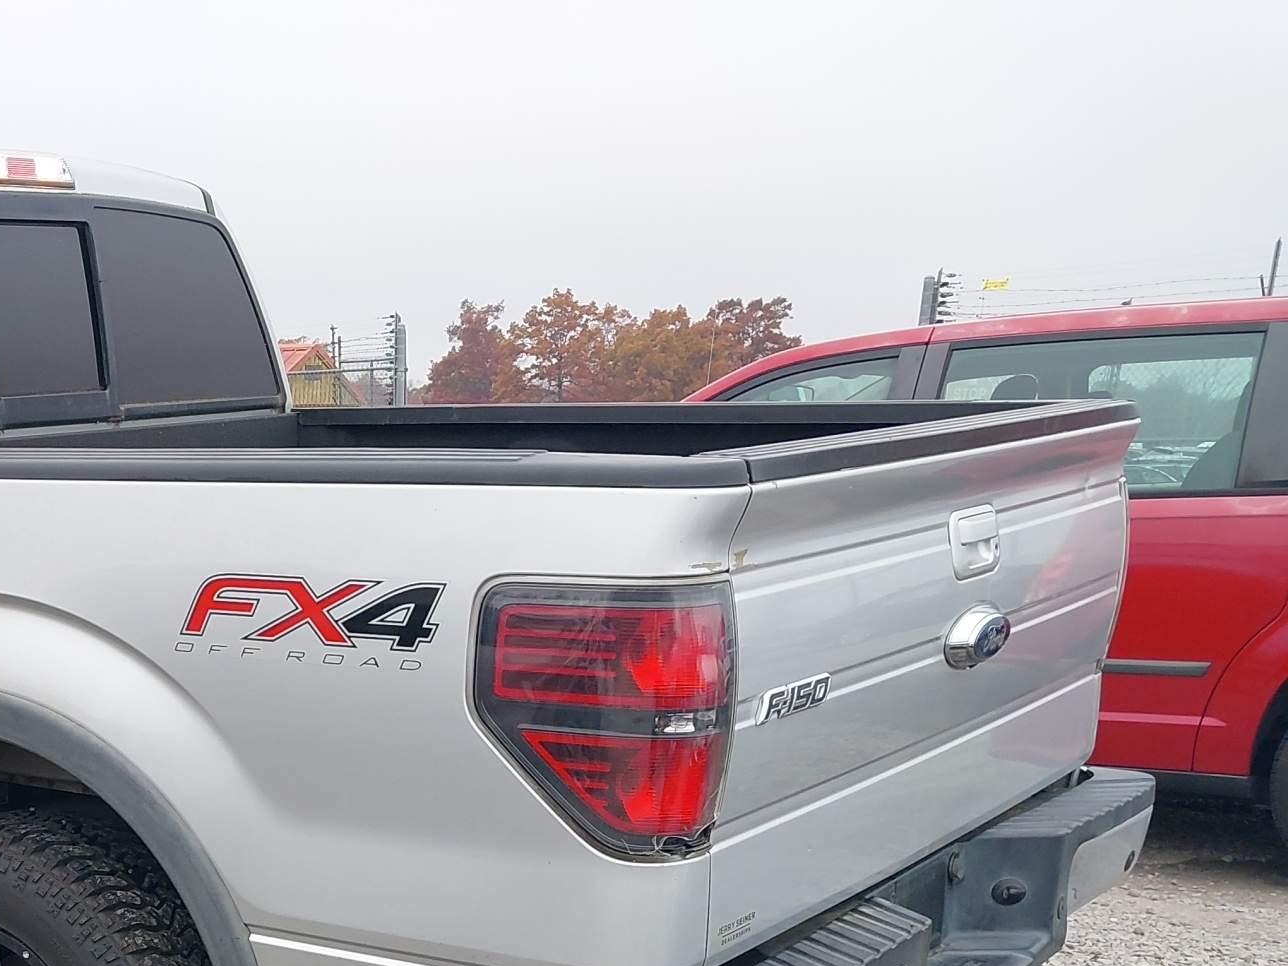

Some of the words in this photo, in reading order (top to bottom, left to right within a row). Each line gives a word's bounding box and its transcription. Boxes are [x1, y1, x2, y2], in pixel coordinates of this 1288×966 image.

[179, 573, 447, 651] FX4
[174, 642, 262, 658] OFF
[285, 651, 422, 671] ROAD
